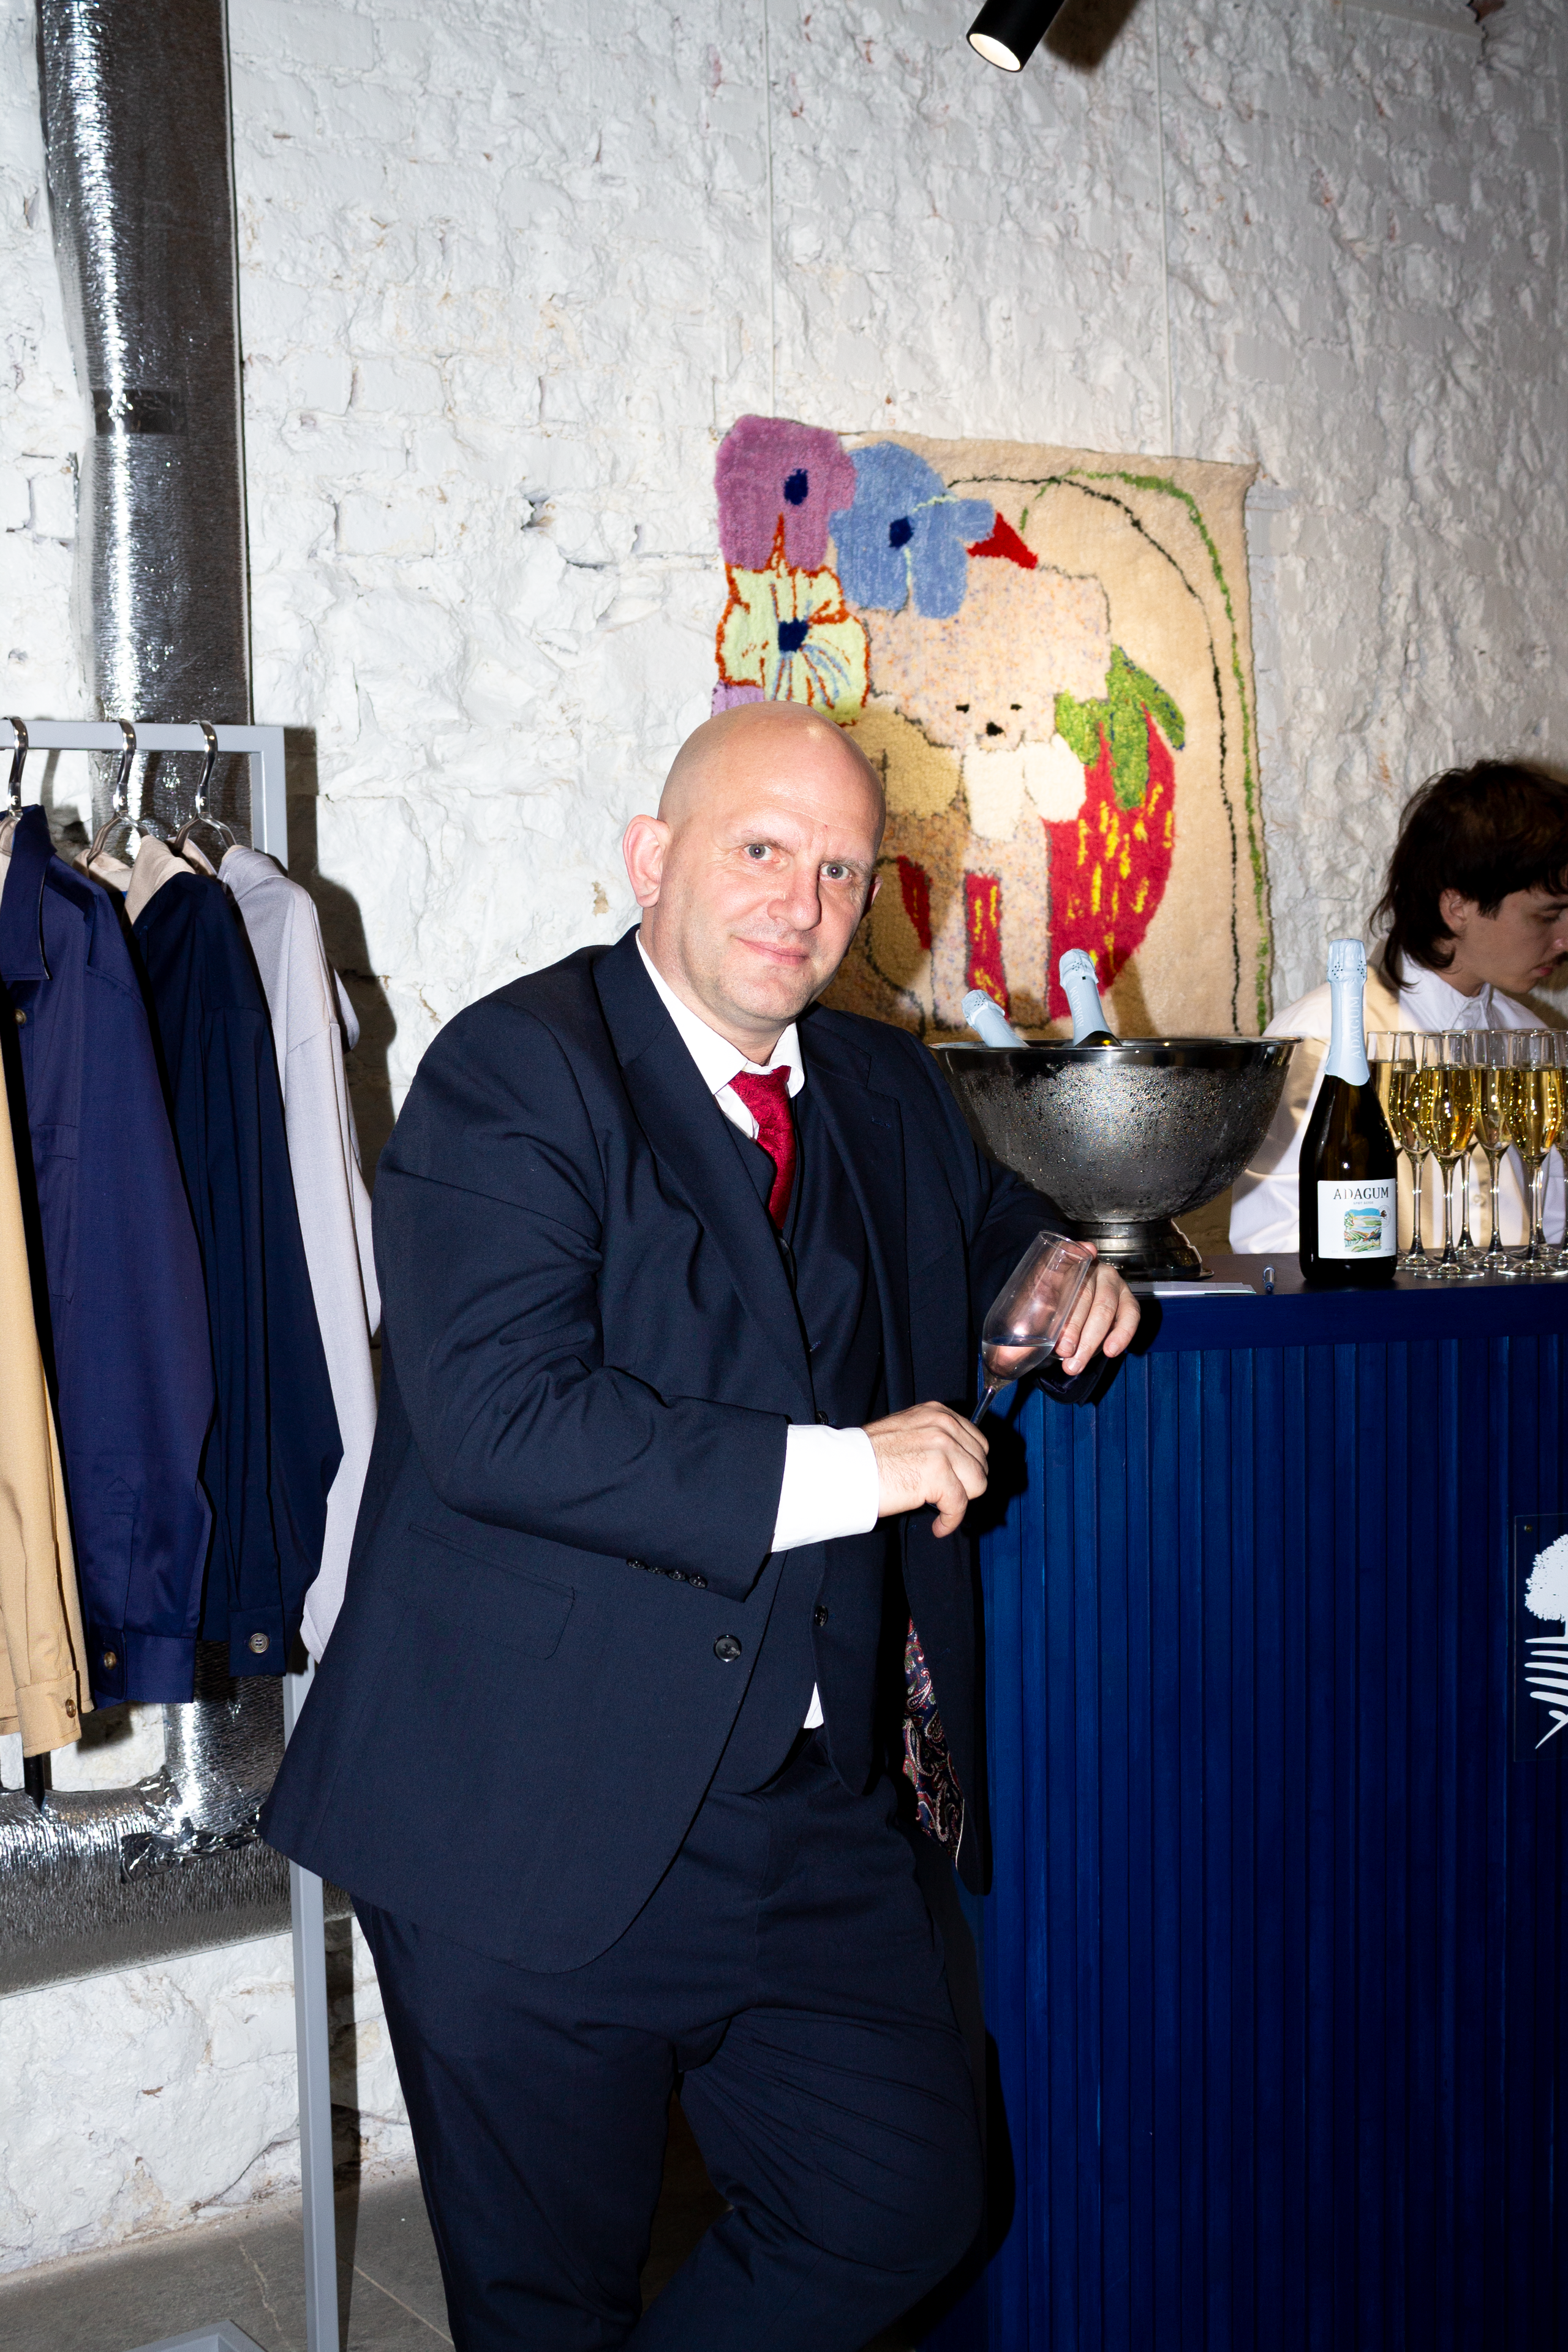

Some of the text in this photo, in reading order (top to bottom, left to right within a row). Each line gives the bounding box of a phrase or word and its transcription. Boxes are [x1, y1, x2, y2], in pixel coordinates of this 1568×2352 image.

[1070, 986, 1084, 1028] ADAGUM
[1350, 997, 1362, 1059] ADAGUM
[1333, 1186, 1389, 1200] ADAGUM
